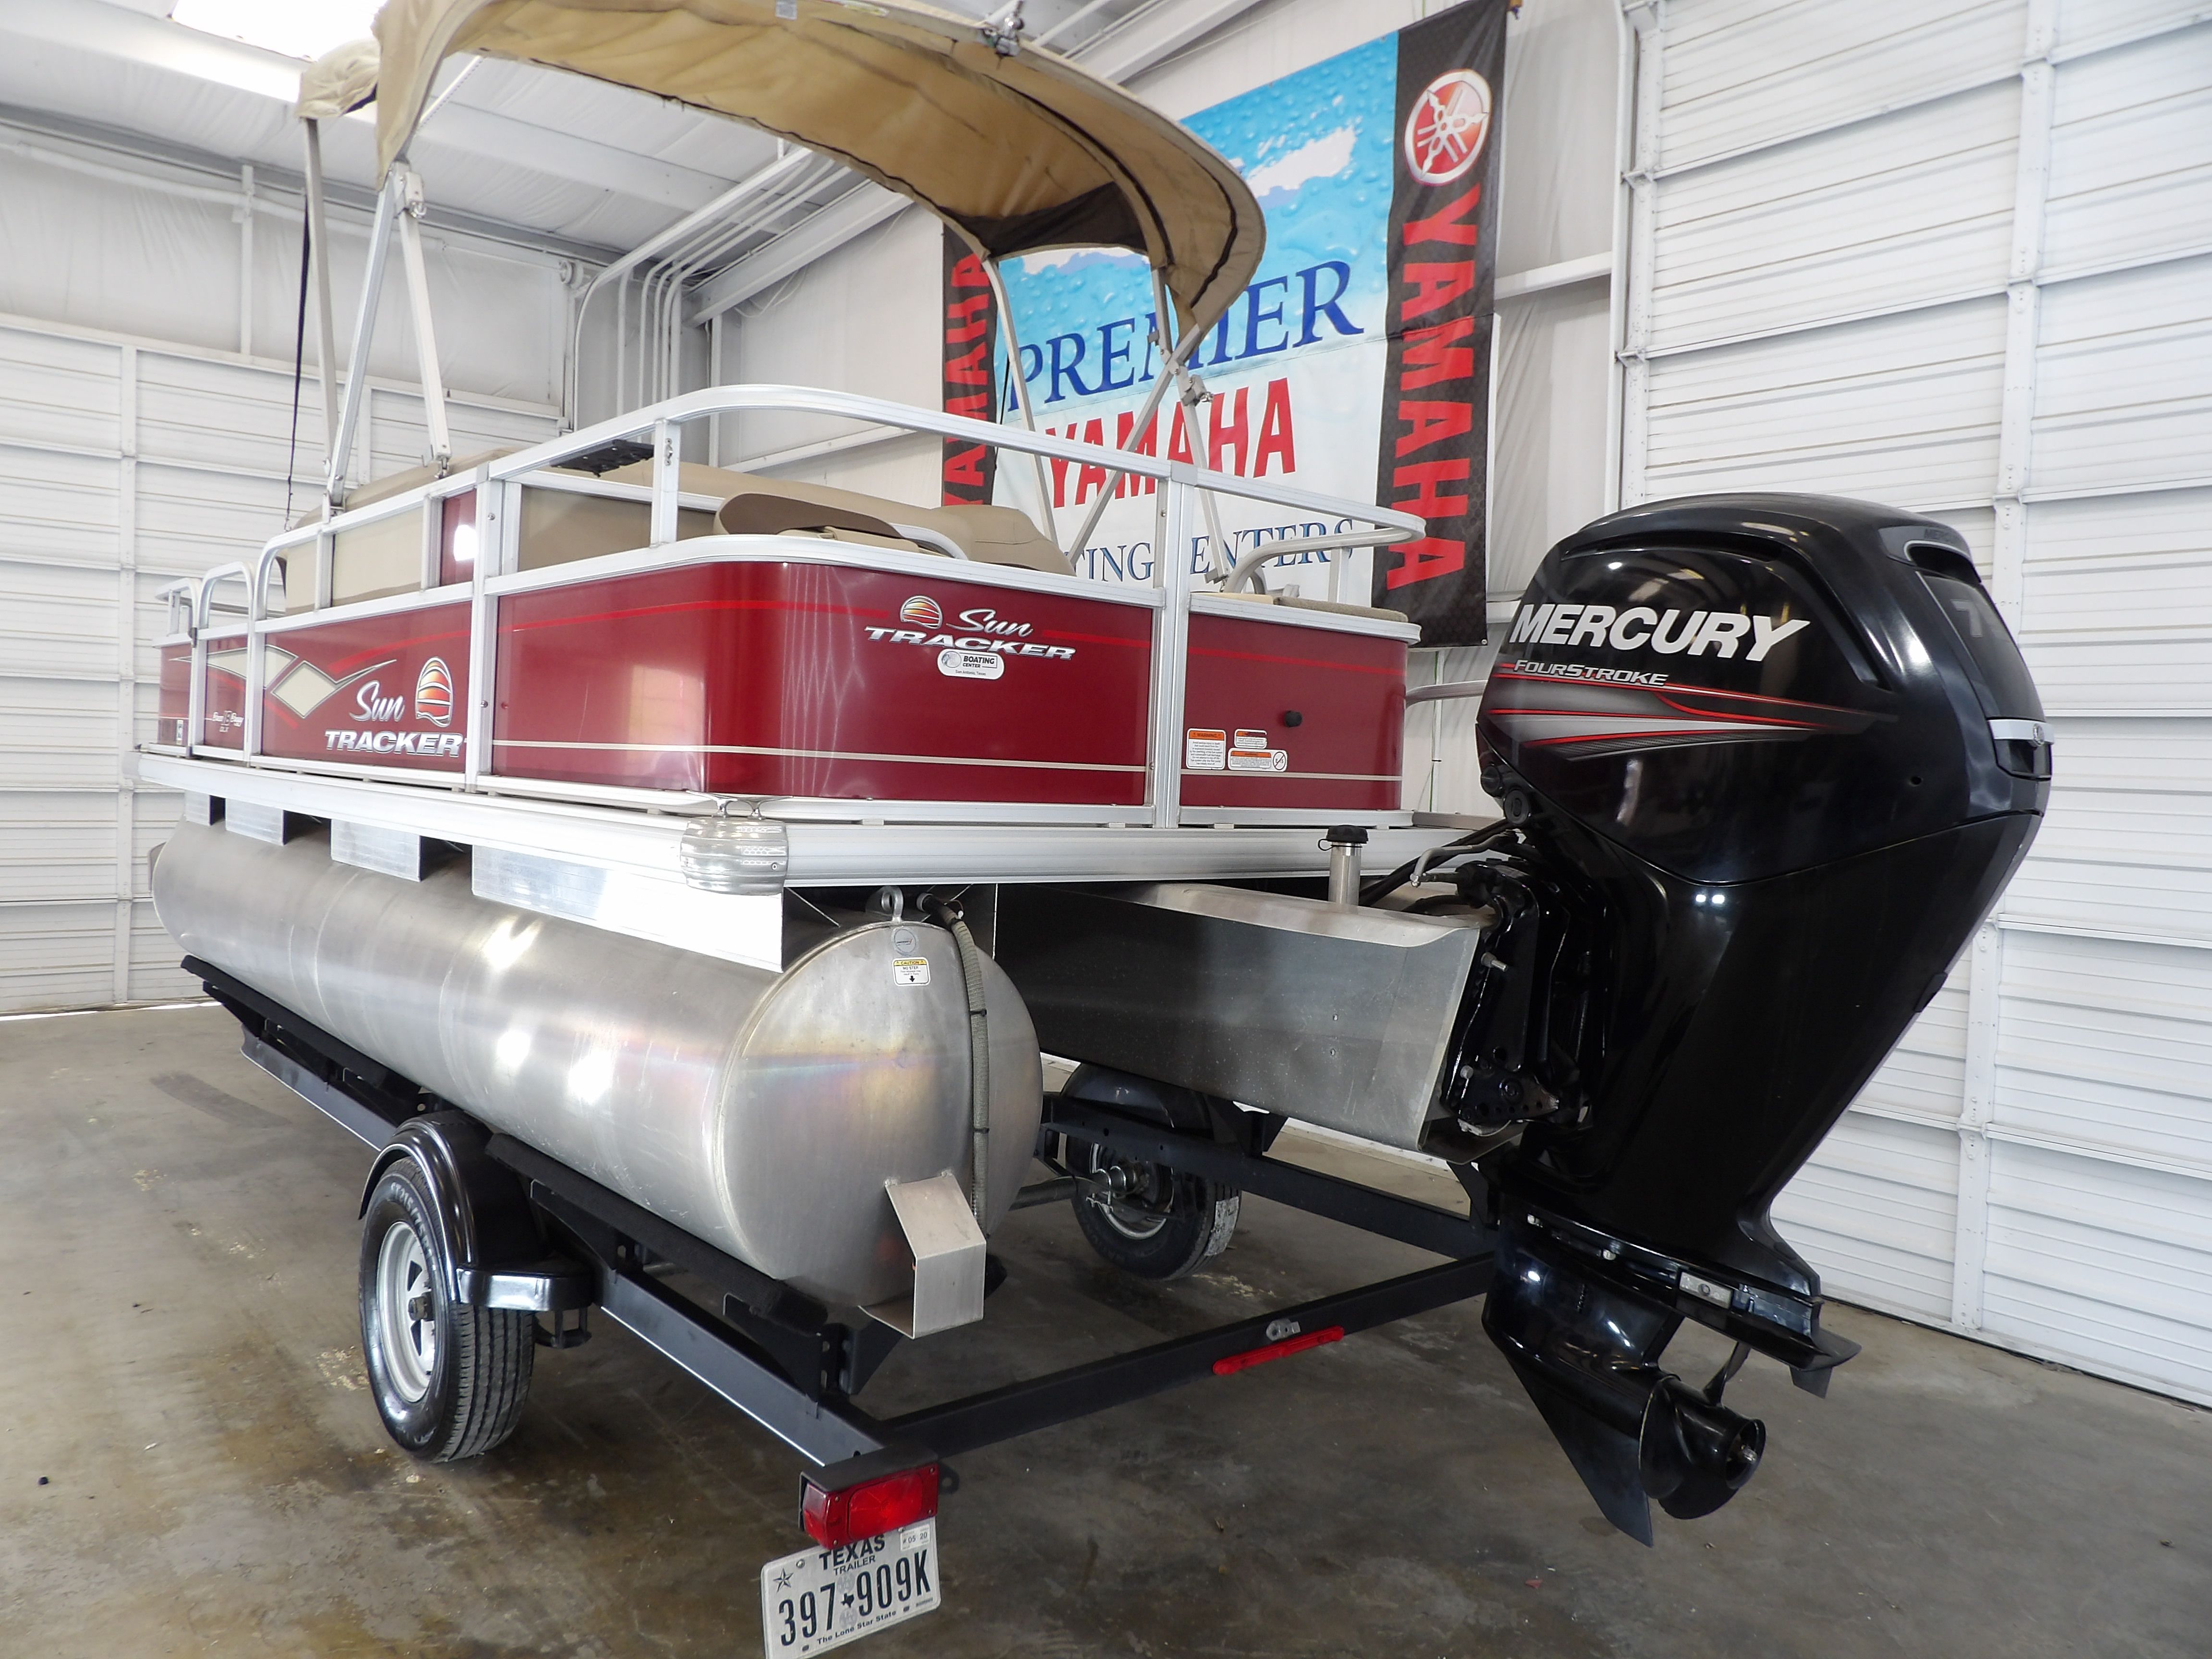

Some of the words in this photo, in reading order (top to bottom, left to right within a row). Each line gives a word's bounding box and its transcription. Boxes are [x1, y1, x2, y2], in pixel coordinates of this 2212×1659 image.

[1387, 182, 1481, 590] YAMAHA
[1046, 377, 1296, 508] YAMAHA
[1190, 519, 1352, 574] ENTERS
[946, 608, 1034, 637] Sun
[1509, 604, 1810, 662] MERCURY
[864, 626, 1076, 661] TRACKER
[963, 656, 995, 664] BOATING
[349, 680, 405, 722] Sun
[325, 730, 463, 757] TRACKER
[819, 1534, 885, 1570] TEXAS
[908, 1536, 916, 1544] 05
[920, 1532, 927, 1540] 20
[833, 1555, 876, 1576] TRAILER
[779, 1582, 836, 1646] 397
[856, 1549, 930, 1616] 909K
[817, 1635, 832, 1645] The
[835, 1626, 854, 1637] Lone
[857, 1619, 873, 1629] Star
[876, 1611, 896, 1622] State
